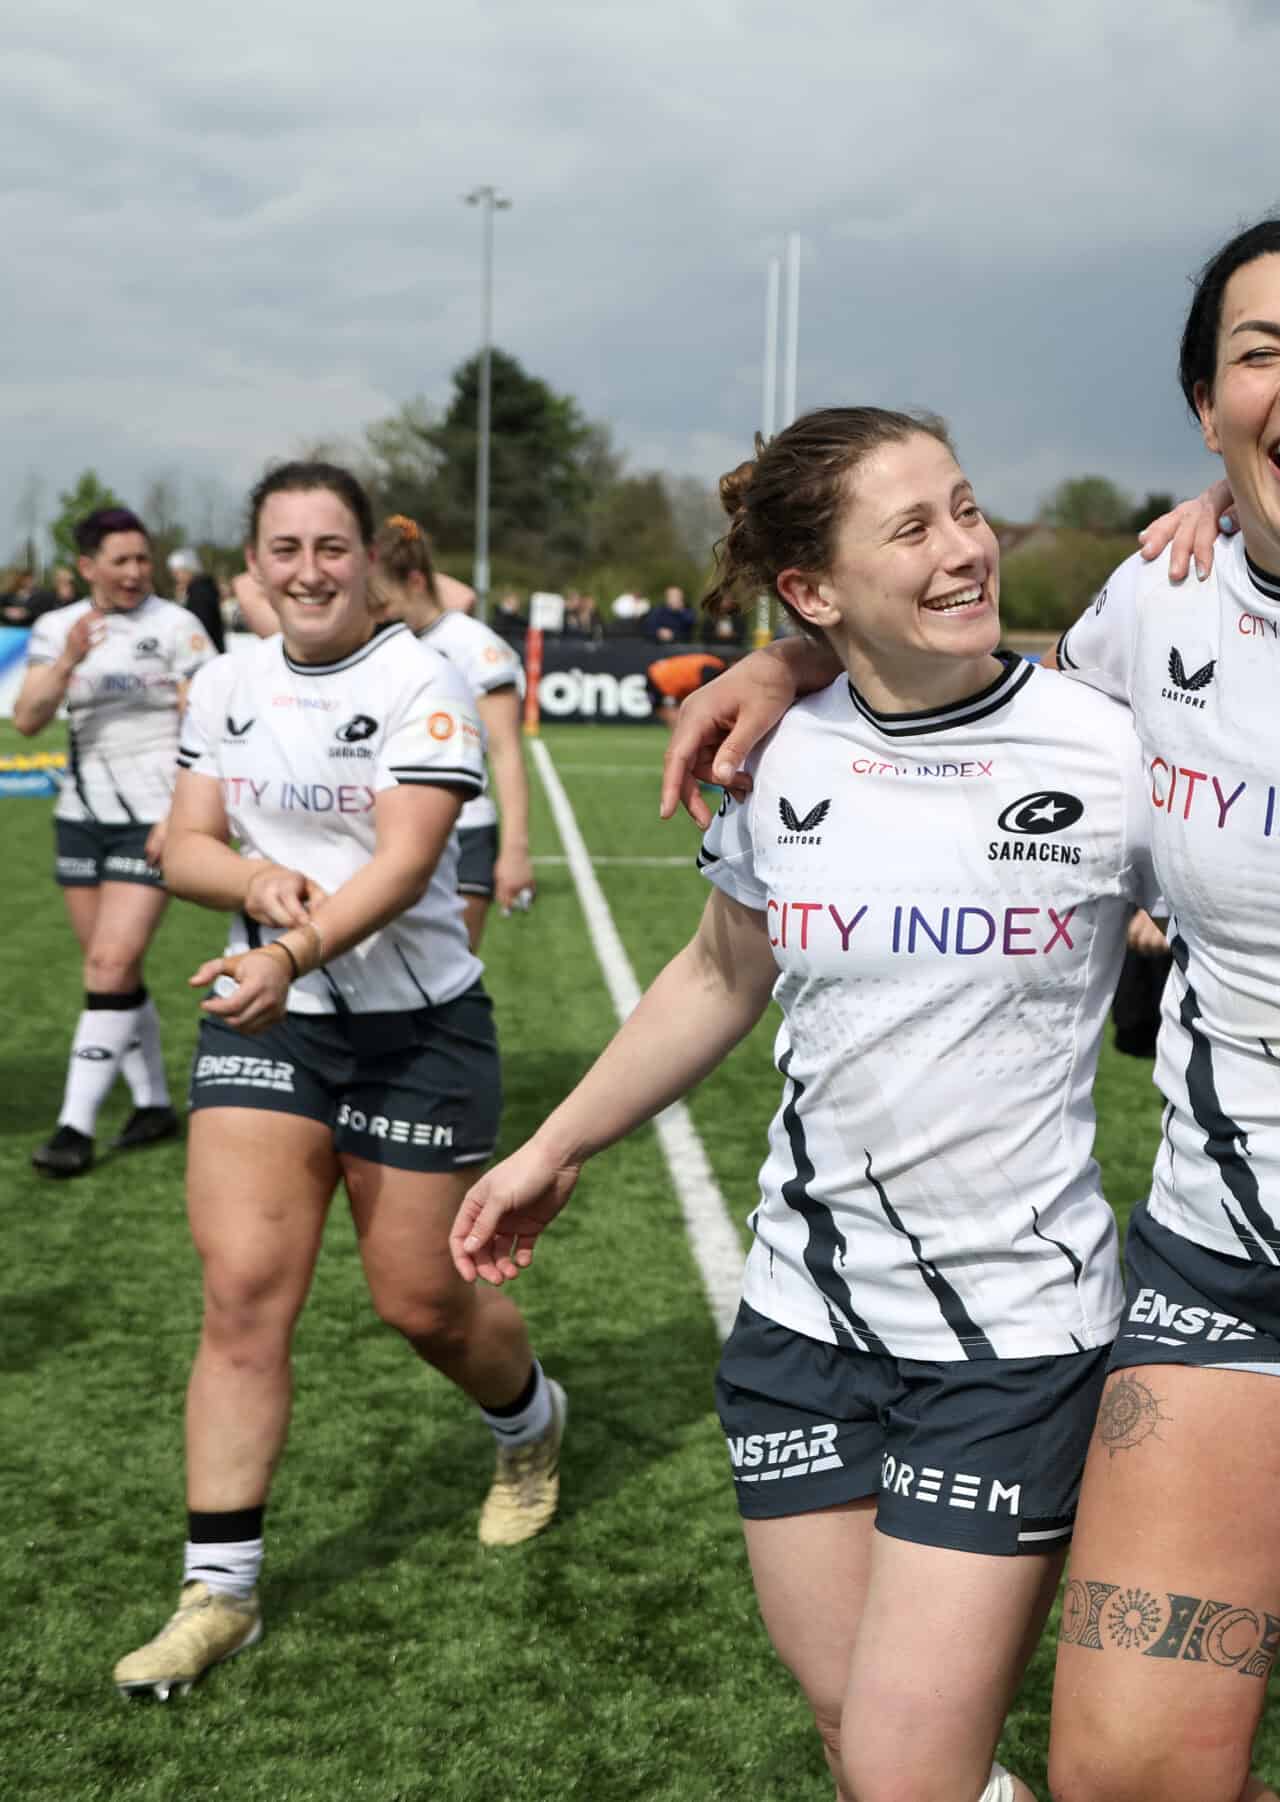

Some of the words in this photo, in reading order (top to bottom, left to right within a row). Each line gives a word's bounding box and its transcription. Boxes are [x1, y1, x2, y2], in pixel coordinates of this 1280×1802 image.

[1238, 612, 1278, 639] CITY
[1161, 687, 1207, 709] CASTORE
[917, 760, 993, 777] INDEX
[1150, 756, 1246, 829] CITY
[777, 835, 822, 846] CASTORE
[988, 841, 1082, 865] SARACENS
[767, 899, 868, 951] CITY
[892, 904, 1077, 955] INDEX
[196, 1055, 296, 1082] ENSTAR
[727, 1423, 839, 1468] NSTAR
